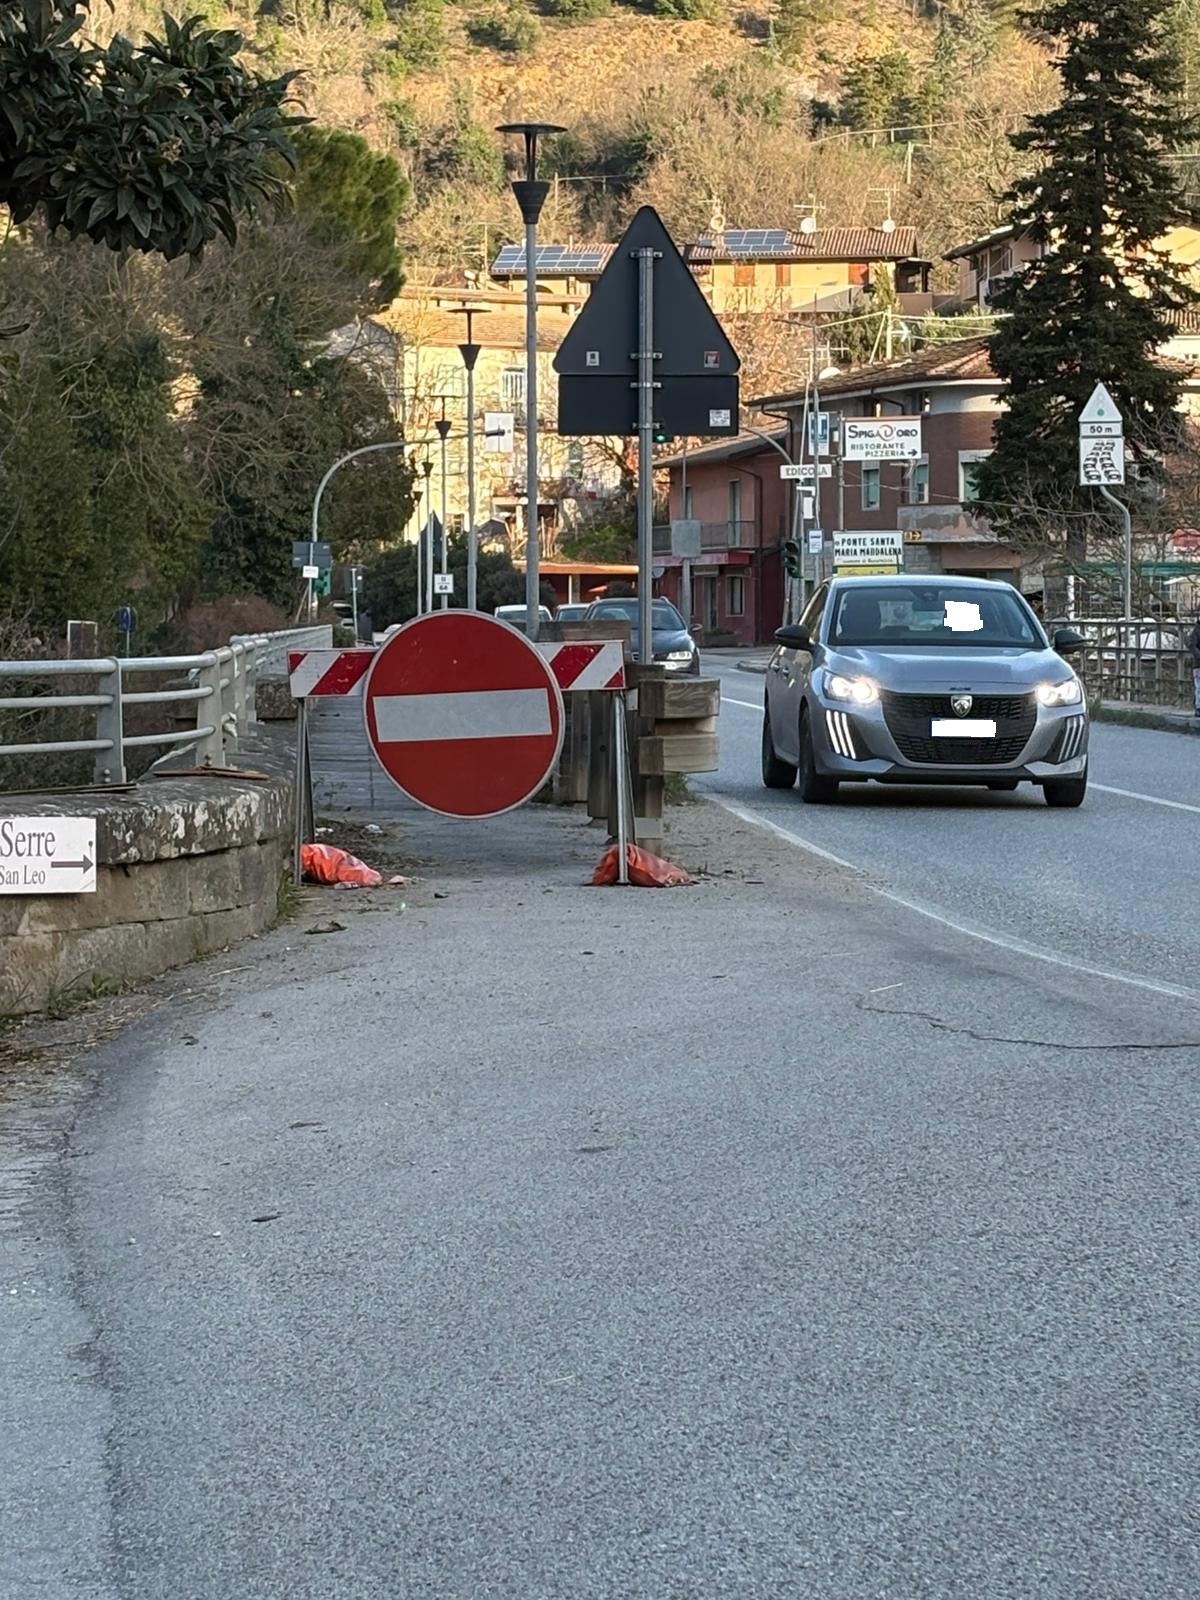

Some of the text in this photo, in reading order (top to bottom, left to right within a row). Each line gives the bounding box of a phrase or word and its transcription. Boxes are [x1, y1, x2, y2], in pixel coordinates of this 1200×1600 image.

[848, 424, 880, 439] SPIGA
[1089, 425, 1103, 433] 50
[850, 442, 905, 451] RISTORANTE
[865, 449, 906, 457] PIZZERIA
[785, 467, 828, 476] EDICOA
[841, 537, 895, 546] PONTE SANTA
[835, 547, 902, 557] MARIA MADDALENA
[0, 820, 57, 857] Serre
[0, 864, 46, 885] San Leo
